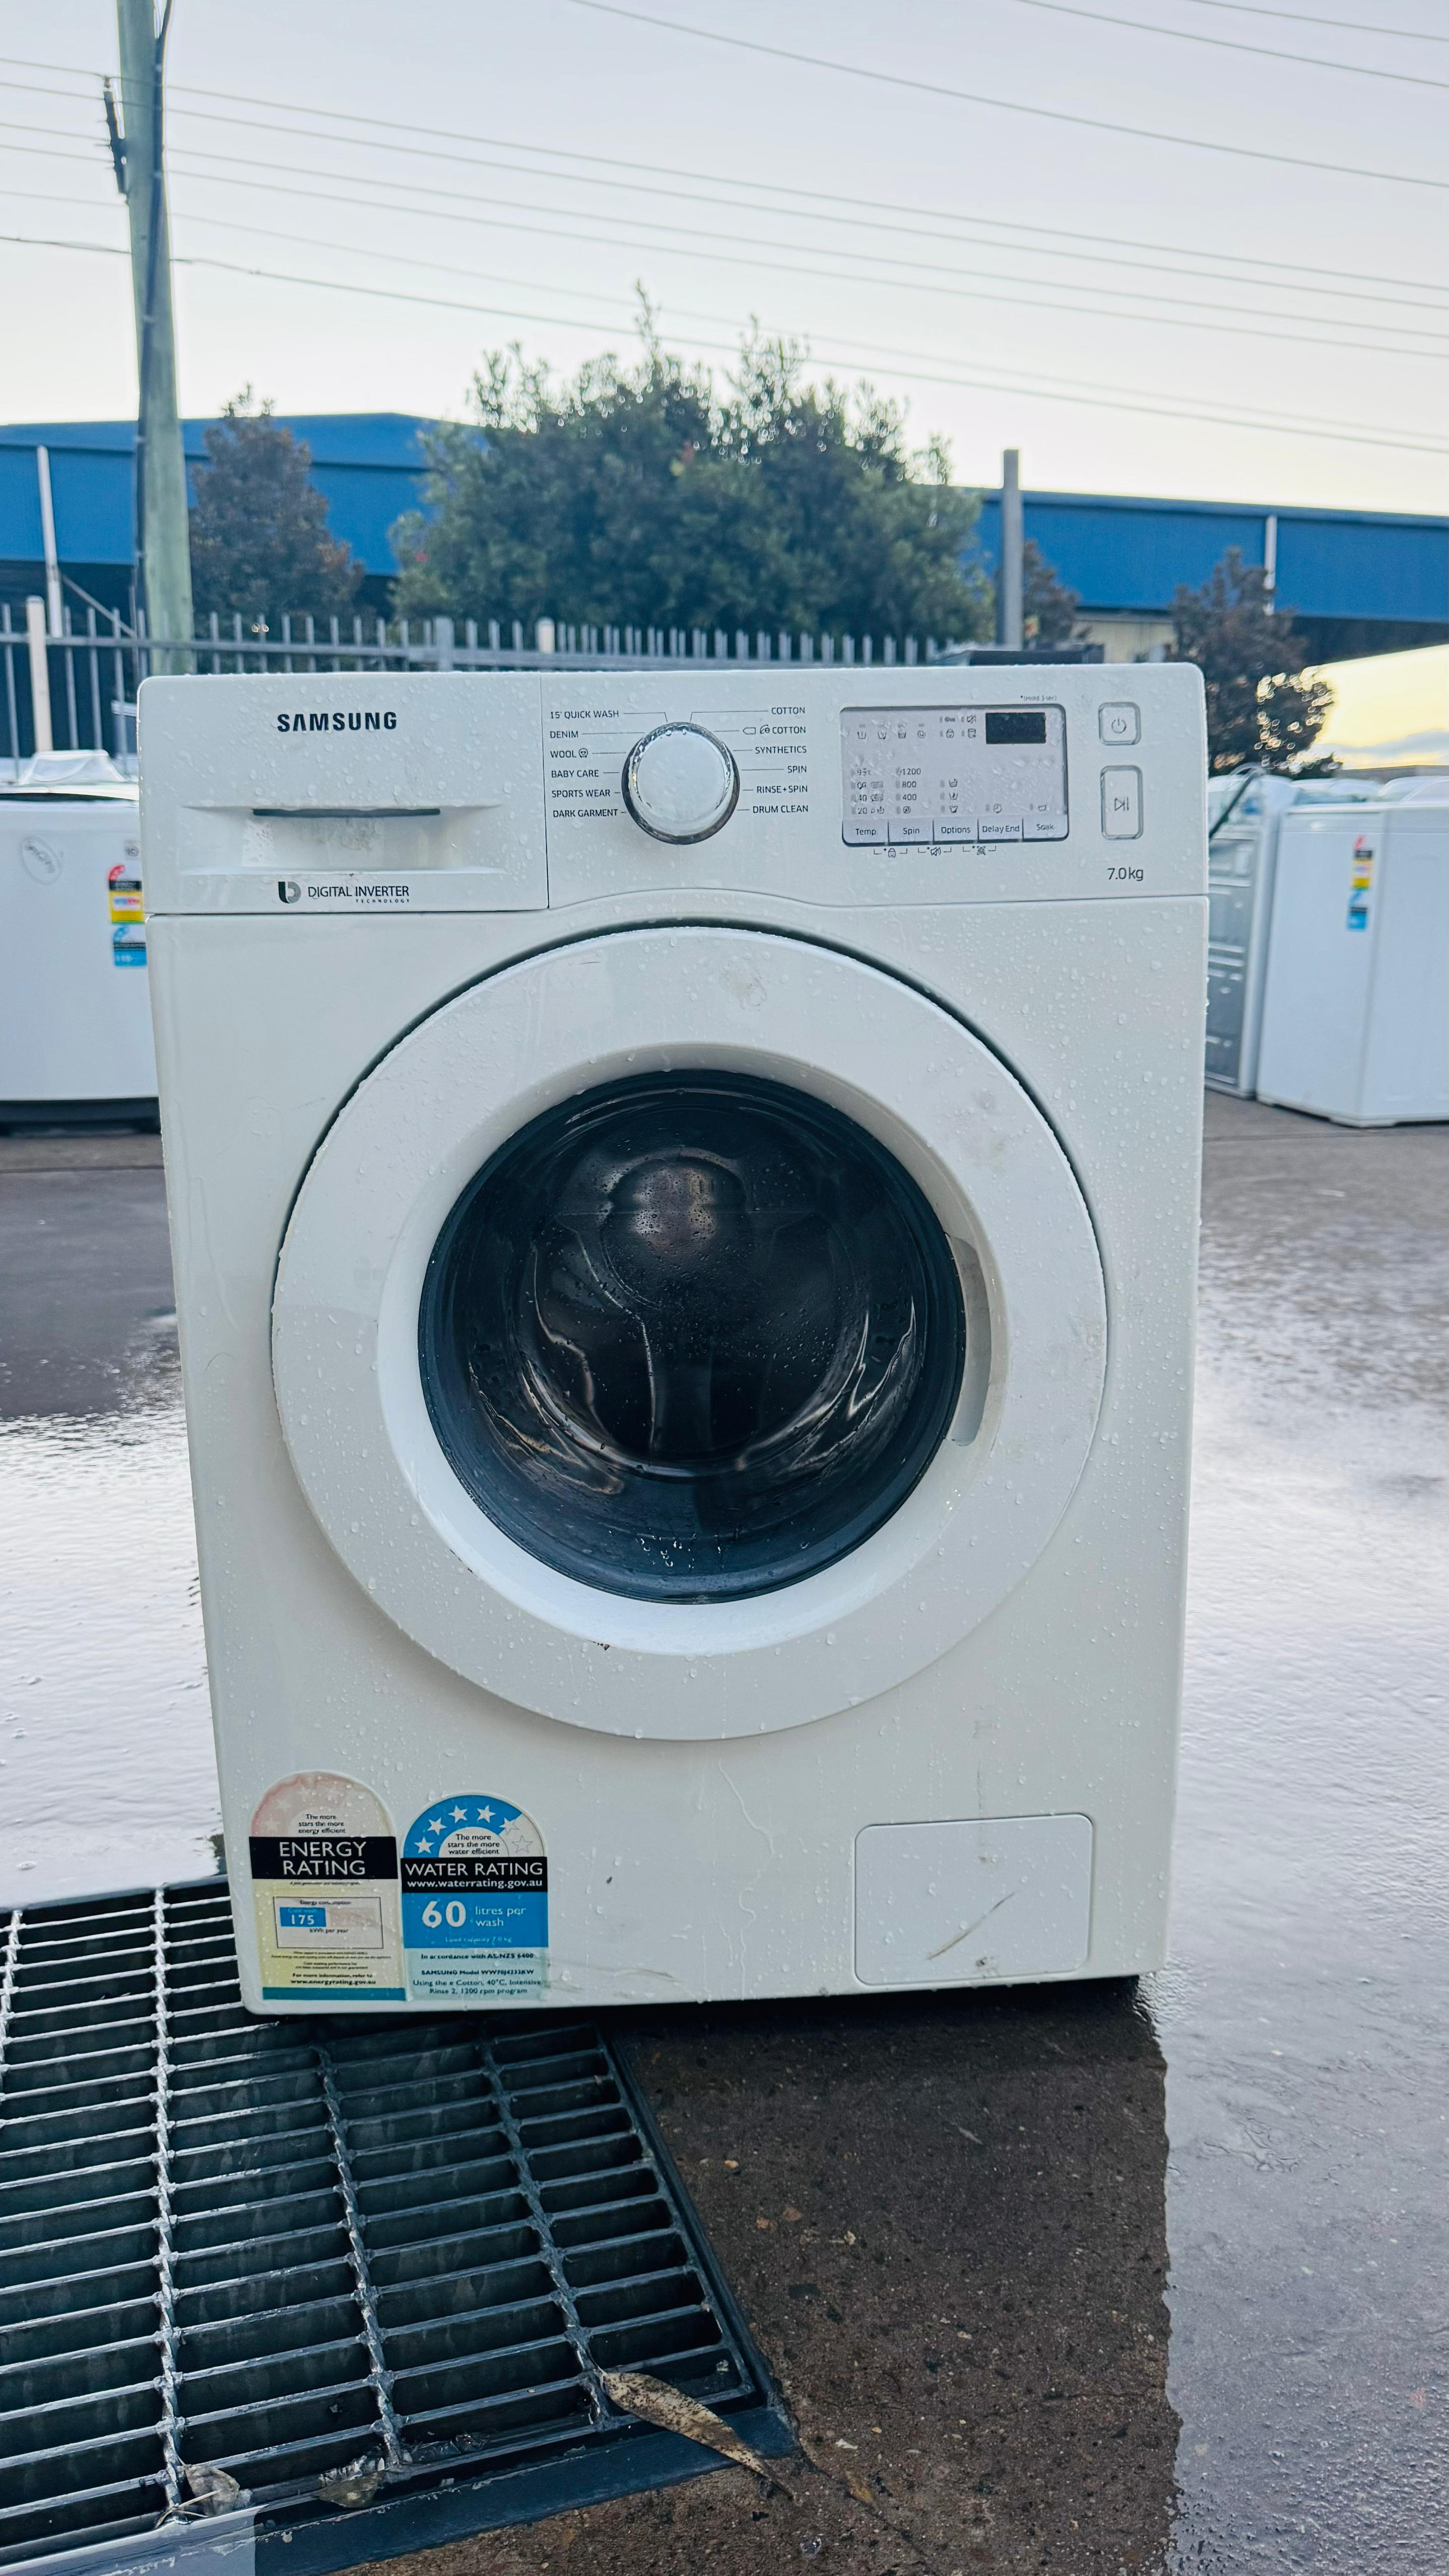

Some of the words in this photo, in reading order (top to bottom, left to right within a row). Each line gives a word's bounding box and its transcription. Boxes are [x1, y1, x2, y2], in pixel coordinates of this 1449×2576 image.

[564, 710, 591, 719] QUICK
[593, 710, 619, 718] WASH
[277, 711, 397, 733] SAMSUNG
[550, 731, 579, 739] DENIM
[550, 750, 577, 758] WOOL
[755, 746, 807, 754] SYNTHETICS
[787, 765, 807, 773] SPIN
[585, 789, 611, 797] WEAR
[553, 810, 576, 818] DARK
[578, 809, 618, 817] GARMENT
[753, 806, 778, 814] DRUM
[780, 805, 809, 813] CLEAN
[982, 825, 1004, 834] Delay
[307, 886, 353, 898] DIGITAL
[355, 886, 410, 897] INVERTER
[279, 1841, 367, 1857] ENERGY
[283, 1860, 366, 1876] RATING
[405, 1863, 468, 1876] WATER
[475, 1863, 543, 1876] RATING
[407, 1878, 543, 1889] www.waterrating.gov.au
[422, 1900, 466, 1928] 60
[475, 1906, 503, 1915] litres
[507, 1907, 526, 1917] per
[291, 1914, 315, 1925] 175
[475, 1917, 504, 1927] wash
